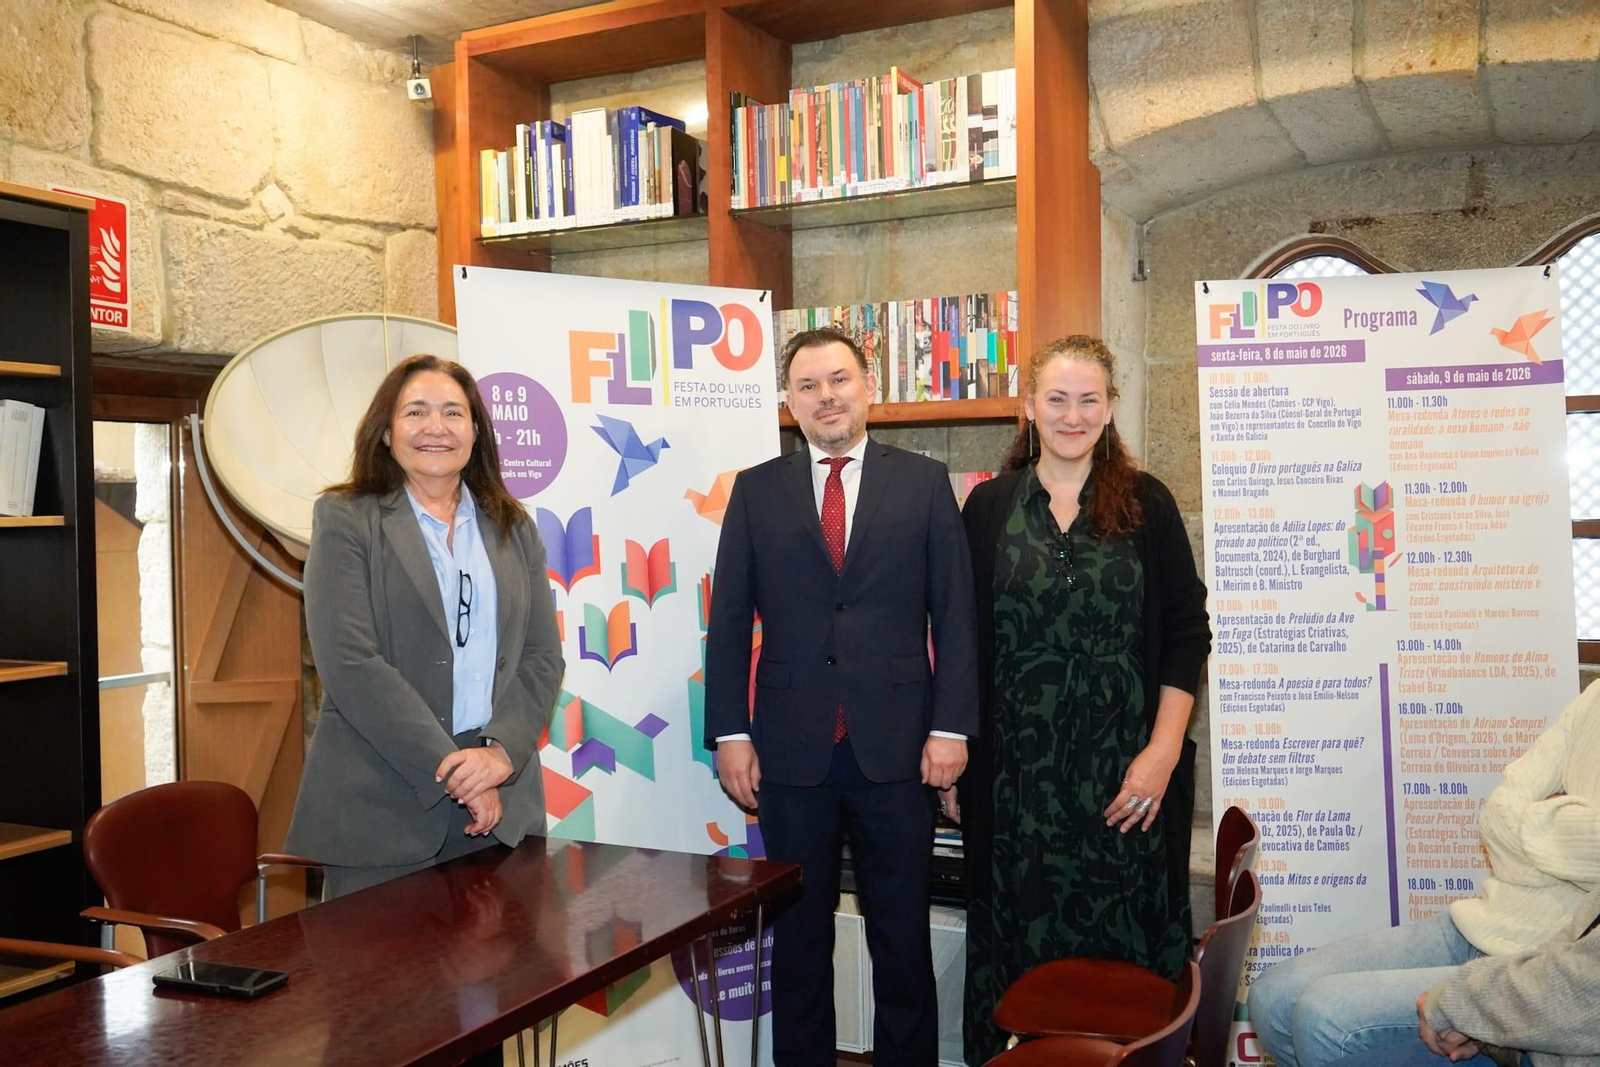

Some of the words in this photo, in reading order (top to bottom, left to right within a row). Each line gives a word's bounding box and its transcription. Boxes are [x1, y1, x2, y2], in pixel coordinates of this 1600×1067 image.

[1344, 308, 1418, 332] Programa
[1267, 324, 1288, 332] FESTA
[1300, 323, 1321, 331] LIVRO
[1279, 330, 1321, 338] PORTUGUÊS
[1211, 348, 1263, 363] sexta-feira,
[1265, 347, 1271, 360] 8
[1273, 347, 1284, 360] de
[1286, 346, 1308, 359] maio
[1311, 346, 1321, 358] de
[1324, 345, 1347, 358] 2026
[1407, 371, 1443, 386] sábado,
[1445, 370, 1451, 383] 9
[1453, 370, 1465, 383] de
[1467, 369, 1490, 382] maio
[1492, 369, 1503, 381] de
[1506, 367, 1531, 381] 2026
[492, 385, 501, 402] 8
[505, 390, 513, 402] e
[518, 386, 527, 403] 9
[674, 381, 707, 393] FESTA
[710, 383, 726, 394] DO
[729, 383, 761, 394] LIVRO
[1209, 386, 1239, 398] Sessão
[1241, 386, 1251, 397] de
[1253, 385, 1289, 397] abertura
[675, 396, 692, 407] EM
[694, 396, 762, 409] PORTUGUÊS
[1388, 397, 1414, 409] 11.00h
[1422, 395, 1448, 408] 11.30h
[492, 404, 528, 422] MAIO
[516, 429, 541, 446] 21h
[504, 459, 525, 467] Centro
[526, 459, 552, 467] Cultural
[1212, 463, 1247, 477] Colóquio
[1250, 462, 1256, 474] O
[1258, 462, 1277, 474] livro
[1278, 461, 1322, 476] português
[1324, 463, 1335, 472] na
[1336, 460, 1362, 472] Galiza
[1405, 482, 1431, 495] 11.30h
[1439, 481, 1468, 493] 12.00h
[1214, 521, 1268, 536] Apresentação
[1270, 521, 1280, 533] de
[1308, 520, 1334, 534] Lopes:
[1335, 519, 1346, 531] do
[1215, 536, 1245, 552] privado
[1246, 538, 1257, 548] ao
[1306, 534, 1321, 548] ed.,
[1215, 550, 1262, 563] Documenta,
[1263, 550, 1290, 562] 2024),
[1292, 549, 1302, 560] de
[1302, 549, 1341, 562] Burghard
[1407, 552, 1435, 564] 12.00h
[1444, 551, 1472, 563] 12.30h
[1216, 565, 1254, 577] Baltrusch
[1256, 564, 1291, 578] (coord.),
[1292, 564, 1299, 576] L.
[1301, 563, 1350, 578] Evangelista,
[1216, 580, 1221, 591] J.
[1253, 582, 1258, 591] e
[1260, 579, 1267, 591] B.
[1269, 578, 1303, 591] Ministro
[1217, 613, 1273, 628] Apresentação
[1276, 613, 1286, 625] de
[1289, 612, 1324, 625] Prelúdio
[1326, 612, 1337, 624] da
[1339, 611, 1355, 624] Ave
[1218, 630, 1230, 640] em
[1232, 628, 1252, 642] Fuga
[1254, 627, 1306, 642] (Estratégias
[1308, 627, 1349, 639] Criativas,
[1218, 642, 1245, 655] 2025),
[1248, 642, 1257, 653] de
[1260, 641, 1295, 653] Catarina
[1298, 641, 1308, 653] de
[1310, 641, 1347, 653] Carvalho
[1397, 639, 1425, 651] 13.00h
[1434, 639, 1462, 651] 14.00h
[1219, 678, 1276, 690] Mesa-redonda
[1278, 677, 1284, 689] A
[1286, 677, 1314, 691] poesia
[1316, 677, 1321, 689] é
[1322, 679, 1342, 691] para
[1344, 676, 1373, 688] todos?
[1399, 703, 1427, 715] 16.00h
[1436, 702, 1463, 714] 17.00h
[1221, 737, 1280, 750] Mesa-redonda
[1283, 737, 1320, 749] Escrever
[1321, 739, 1342, 751] para
[1343, 736, 1365, 751] quê?
[1223, 752, 1236, 765] Um
[1238, 752, 1267, 764] debate
[1269, 754, 1286, 764] sem
[1289, 751, 1316, 764] filtros
[1403, 783, 1431, 795] 17.00h
[1439, 782, 1468, 795] 18.00h
[1283, 810, 1293, 822] de
[1296, 810, 1313, 822] Flor
[1315, 810, 1326, 822] da
[1328, 810, 1351, 822] Lama
[1262, 825, 1274, 838] Oz,
[1276, 825, 1305, 839] 2025),
[1307, 825, 1317, 836] de
[1320, 824, 1344, 836] Paula
[1346, 824, 1356, 836] Oz
[1262, 840, 1302, 851] evocativa
[1305, 840, 1315, 851] de
[1317, 839, 1350, 851] Camões
[1288, 874, 1312, 885] Mitos
[1314, 876, 1319, 885] e
[1321, 873, 1354, 888] origens
[1356, 873, 1367, 885] da
[1408, 878, 1436, 890] 18.00h
[1445, 878, 1474, 891] 19.00h
[744, 938, 755, 951] de
[718, 967, 735, 977] livros
[736, 963, 754, 973] novos
